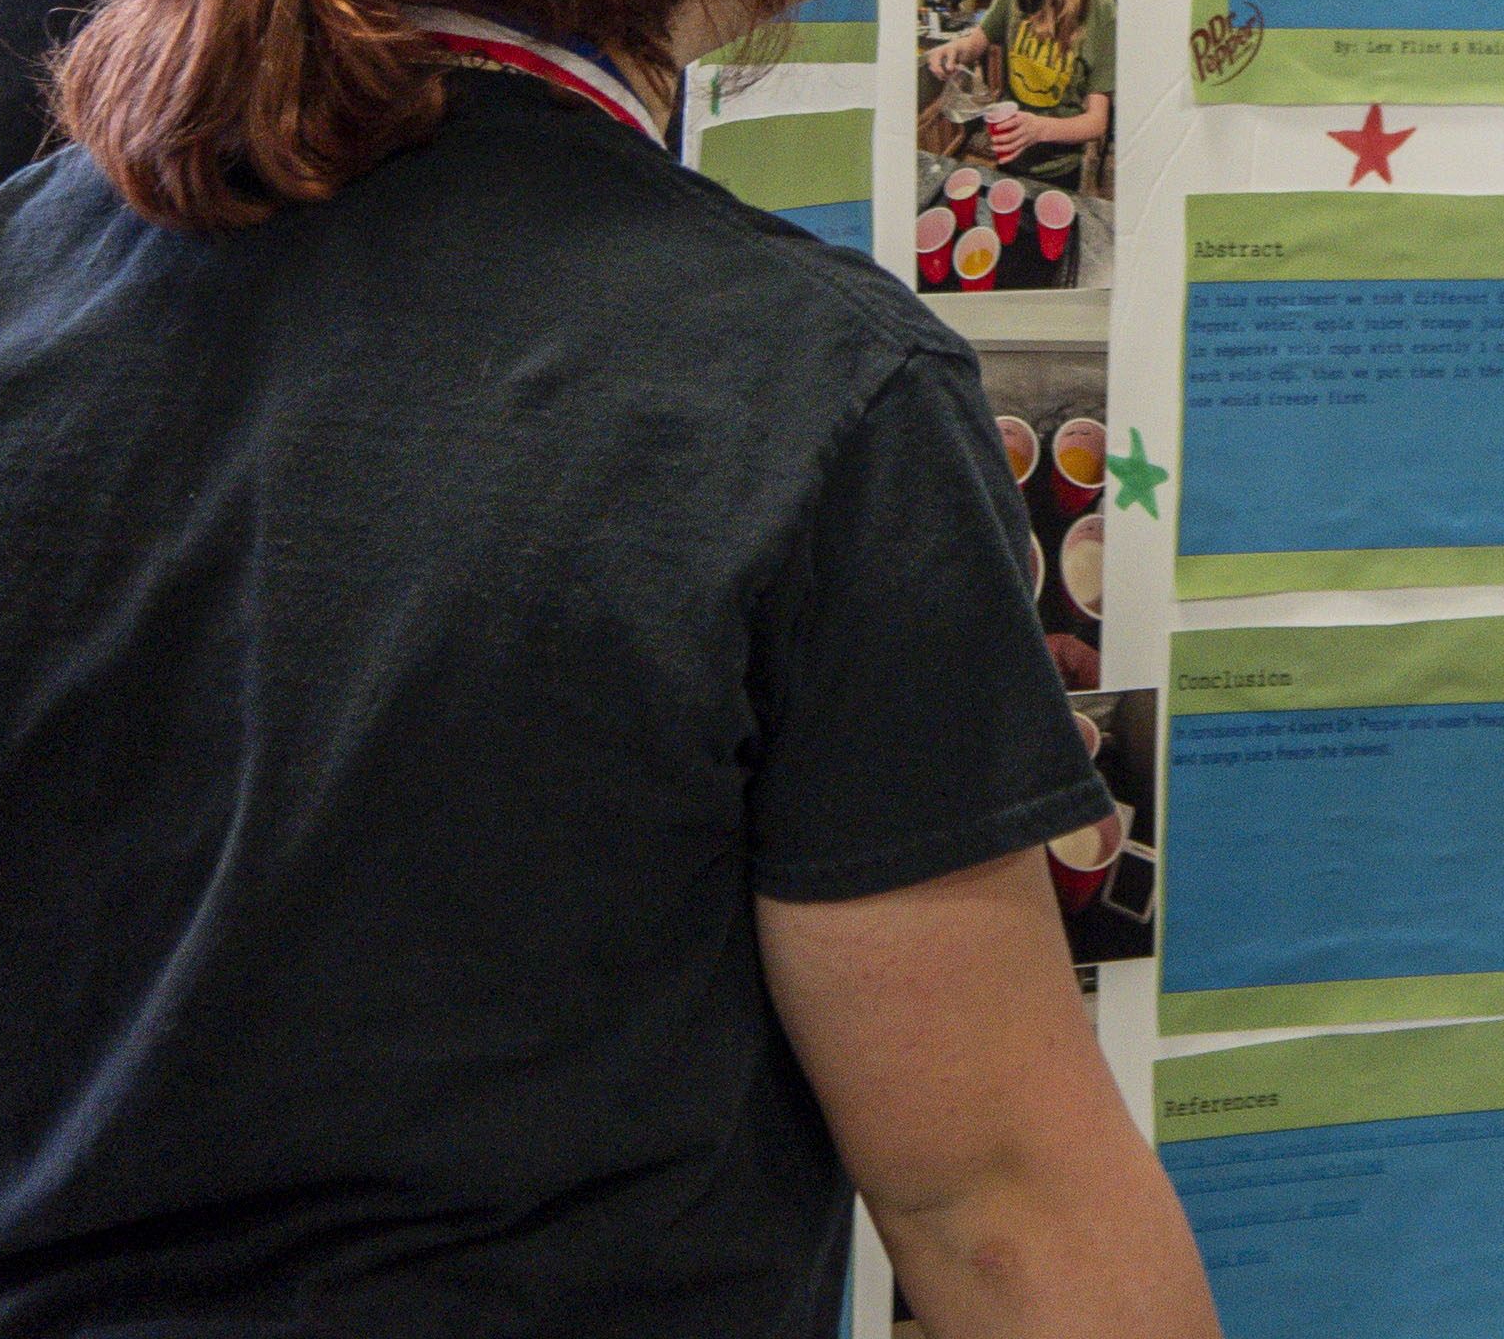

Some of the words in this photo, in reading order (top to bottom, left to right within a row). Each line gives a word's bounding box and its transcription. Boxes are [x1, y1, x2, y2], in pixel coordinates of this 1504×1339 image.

[1192, 240, 1286, 260] Abstract
[1177, 669, 1294, 692] Conclusion
[1163, 1091, 1281, 1120] References
